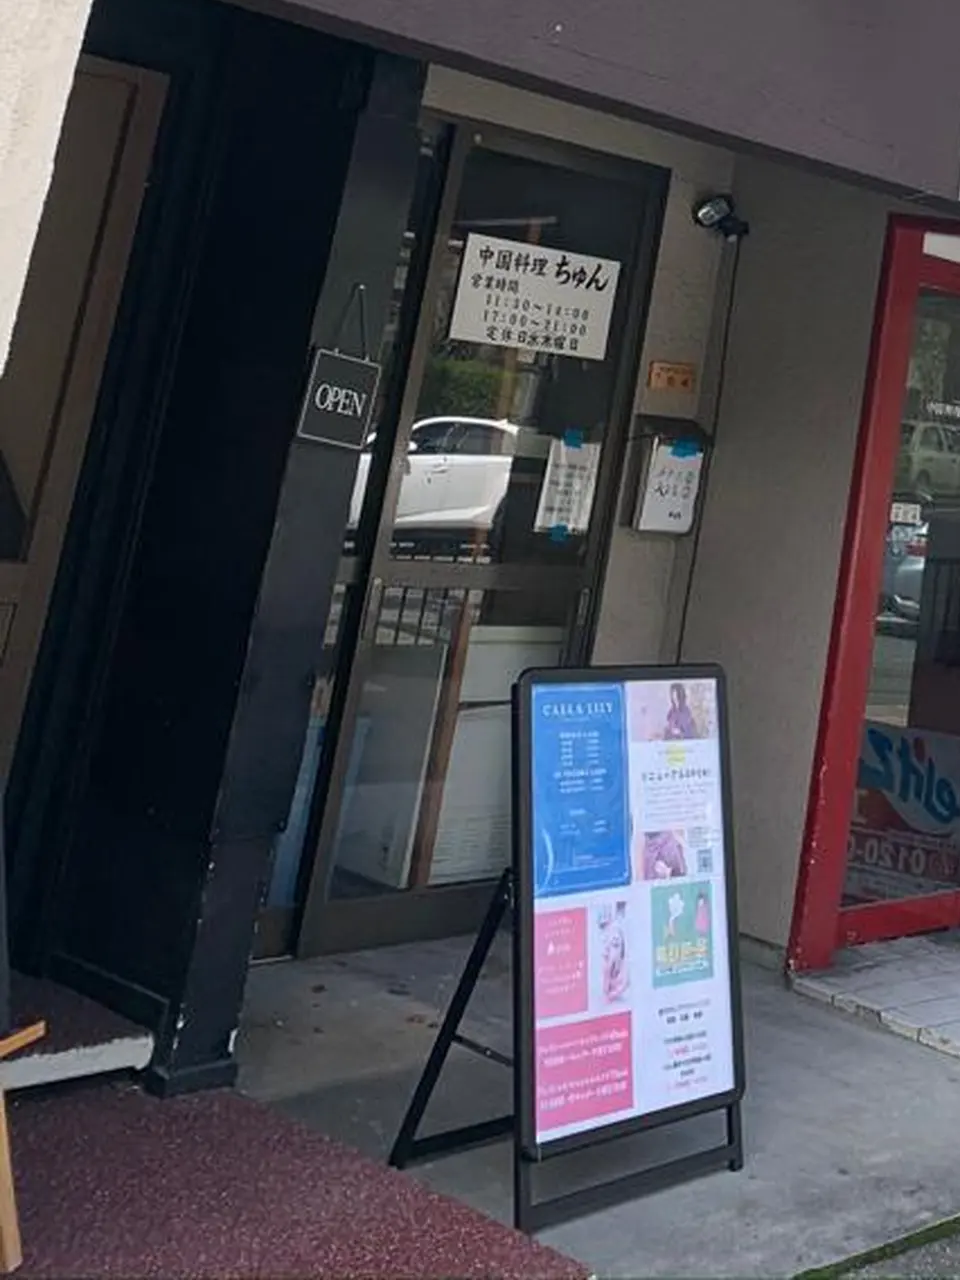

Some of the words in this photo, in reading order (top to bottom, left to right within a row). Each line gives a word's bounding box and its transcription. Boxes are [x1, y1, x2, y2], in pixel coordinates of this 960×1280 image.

[471, 273, 520, 295] 営業時間
[479, 245, 550, 277] 中国料理
[554, 254, 610, 292] ちゅん
[315, 383, 367, 417] OPEN
